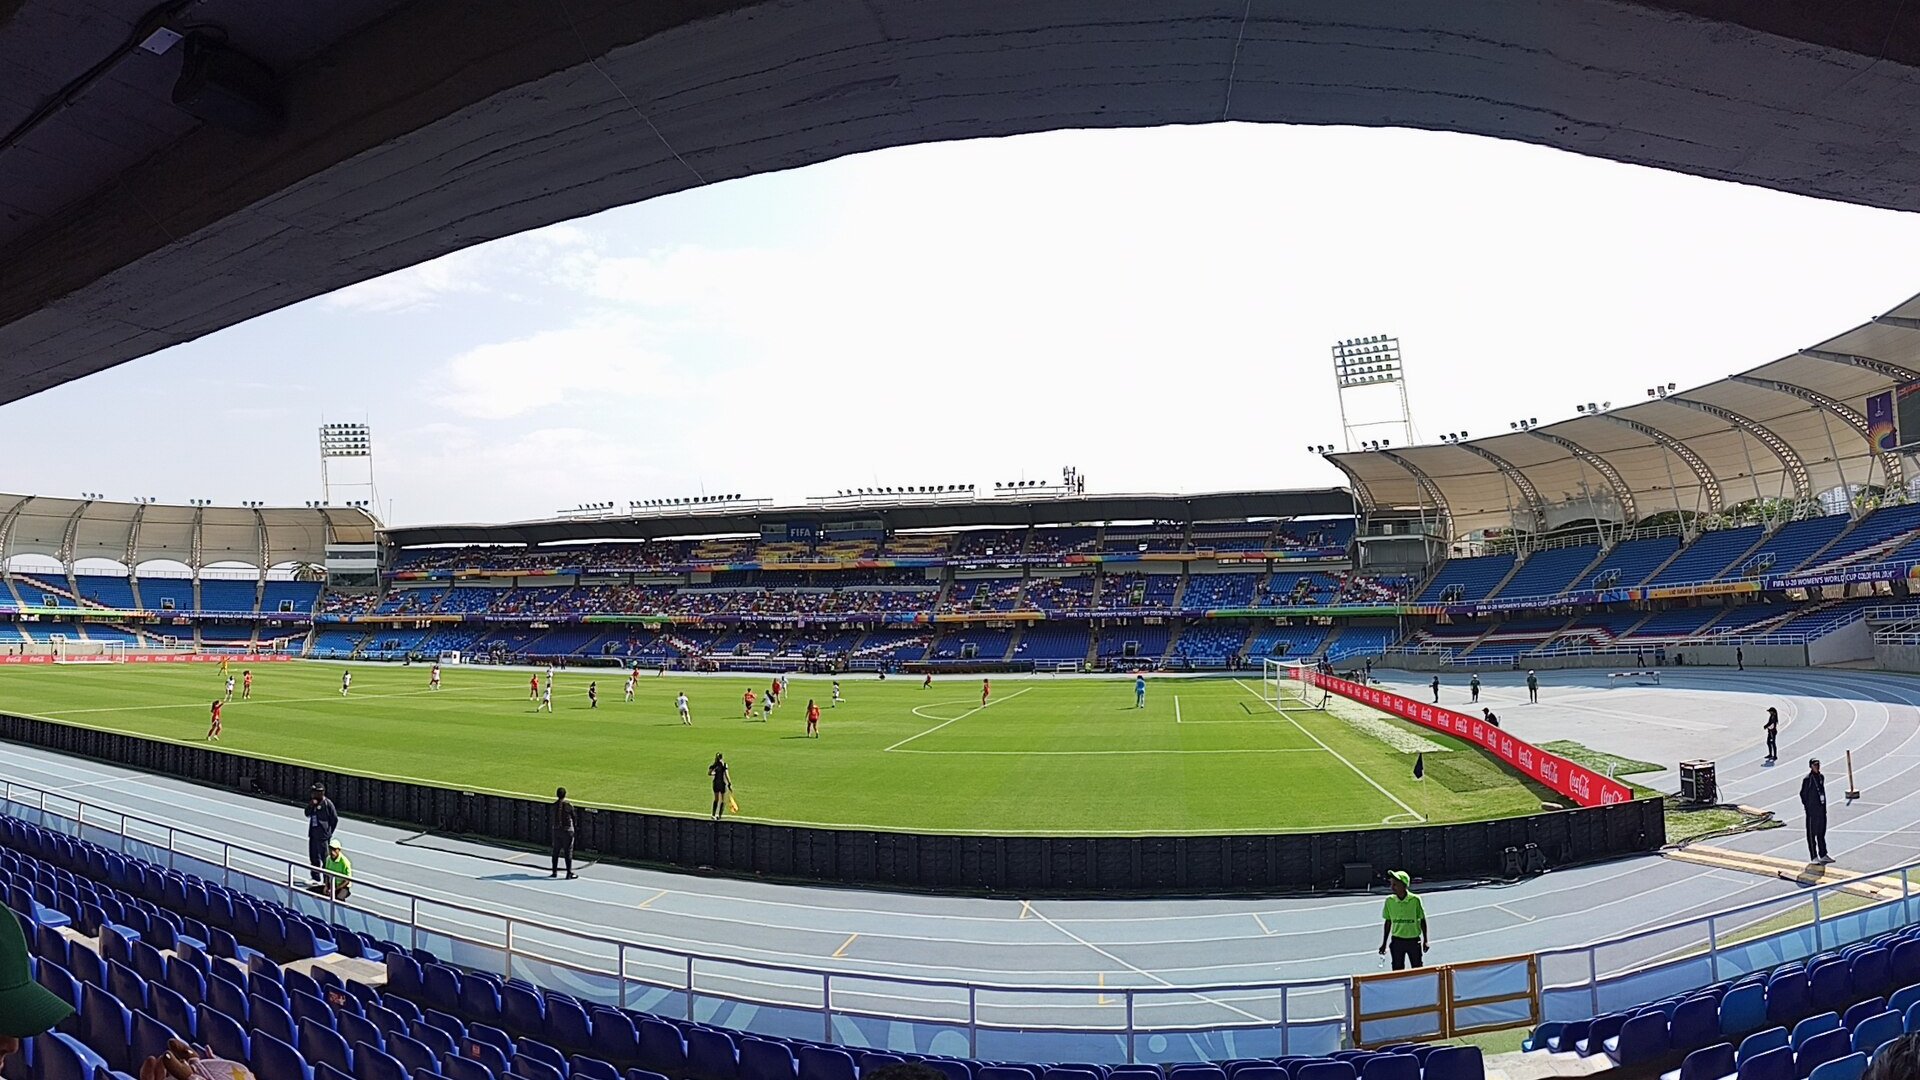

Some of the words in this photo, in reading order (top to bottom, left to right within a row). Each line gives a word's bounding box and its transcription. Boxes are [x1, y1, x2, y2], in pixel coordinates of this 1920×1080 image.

[790, 528, 811, 537] FIFA
[1772, 579, 1784, 588] FIFA
[1785, 578, 1797, 587] U-20
[1797, 576, 1824, 586] WOMEN'S
[1823, 574, 1845, 584] WORLD
[1846, 573, 1857, 582] CUP
